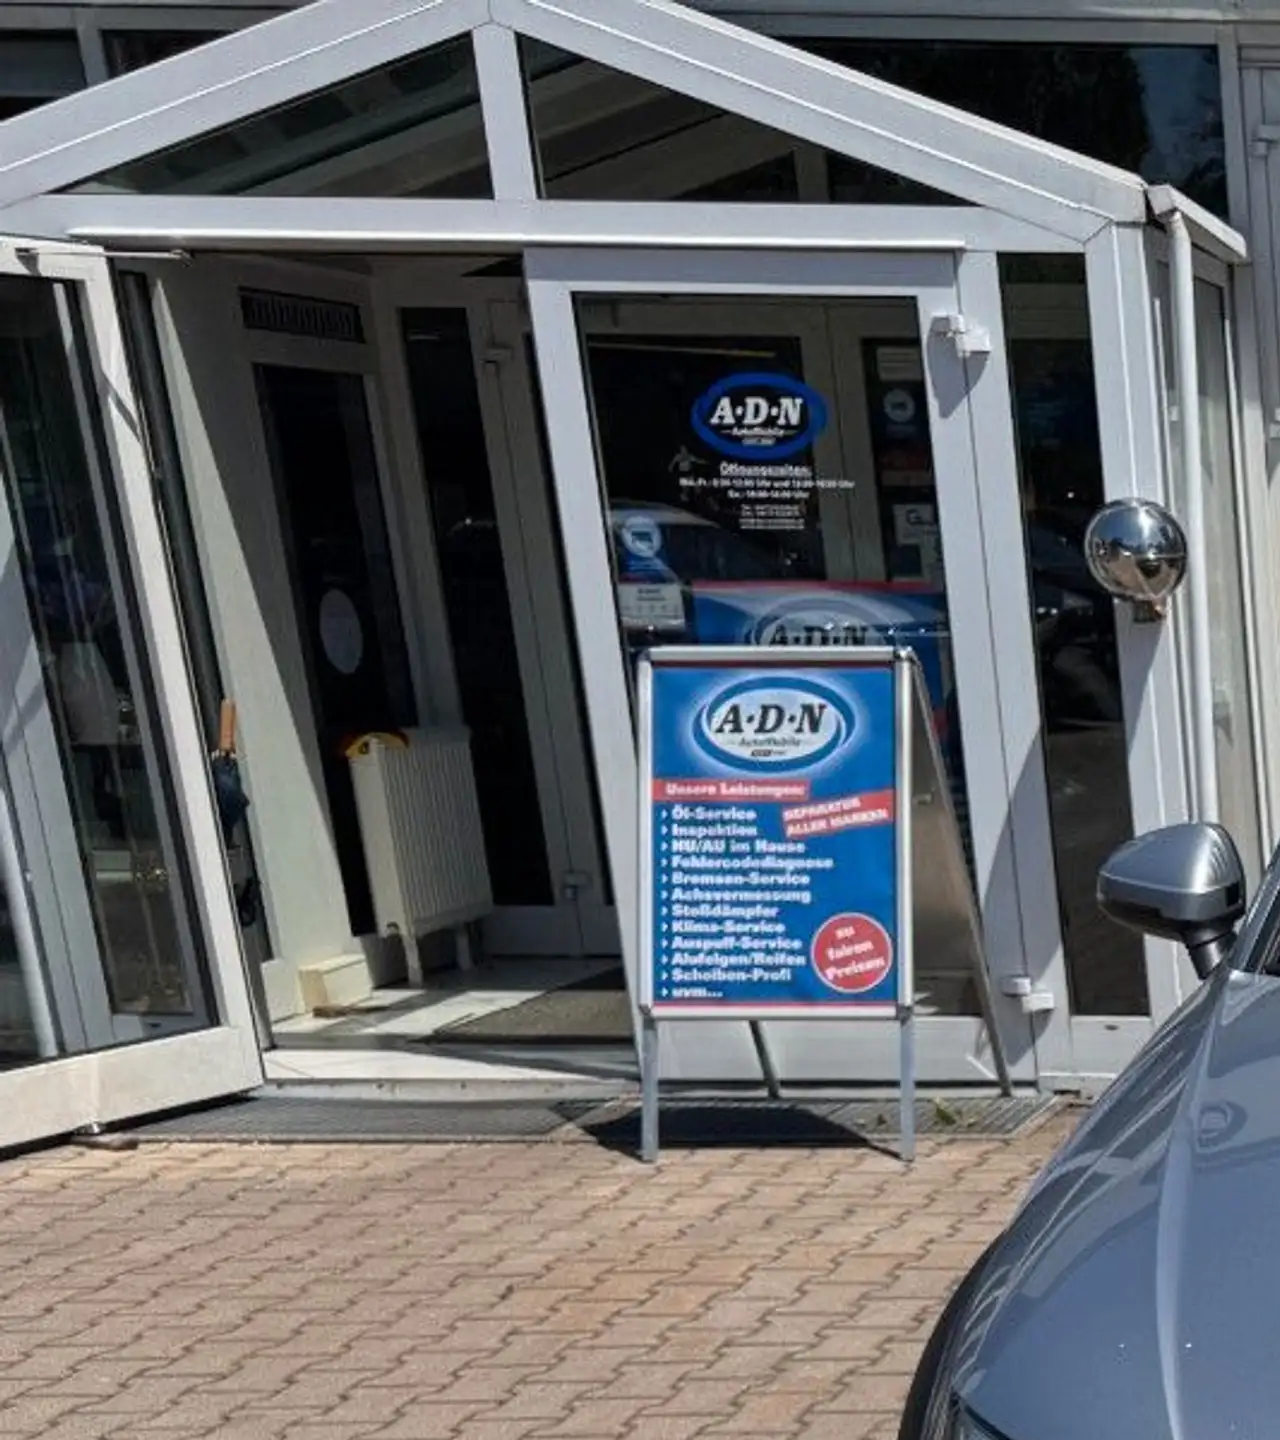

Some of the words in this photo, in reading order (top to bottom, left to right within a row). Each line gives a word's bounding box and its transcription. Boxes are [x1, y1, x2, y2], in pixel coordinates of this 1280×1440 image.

[666, 783, 716, 796] Unsere
[721, 783, 805, 798] Leistungen:
[671, 806, 757, 821] Öl-Service
[830, 808, 889, 829] MARKEN
[672, 824, 757, 838] Inspektion
[672, 840, 725, 853] HU/AU
[730, 841, 749, 853] im
[756, 841, 805, 853] Hause
[672, 857, 834, 870] Fehlercodediagnose
[672, 872, 810, 885] Bremsen-Service
[672, 889, 811, 903] Achsvermessung
[672, 904, 779, 918] Stoßdämpfer
[672, 920, 785, 933] Klima-Service
[672, 936, 802, 950] Auspuff-Service
[828, 940, 874, 960] fairen
[672, 953, 805, 967] Alufelgen/Reifen
[672, 969, 791, 982] Scheiben-Profi
[825, 957, 885, 980] Preisen
